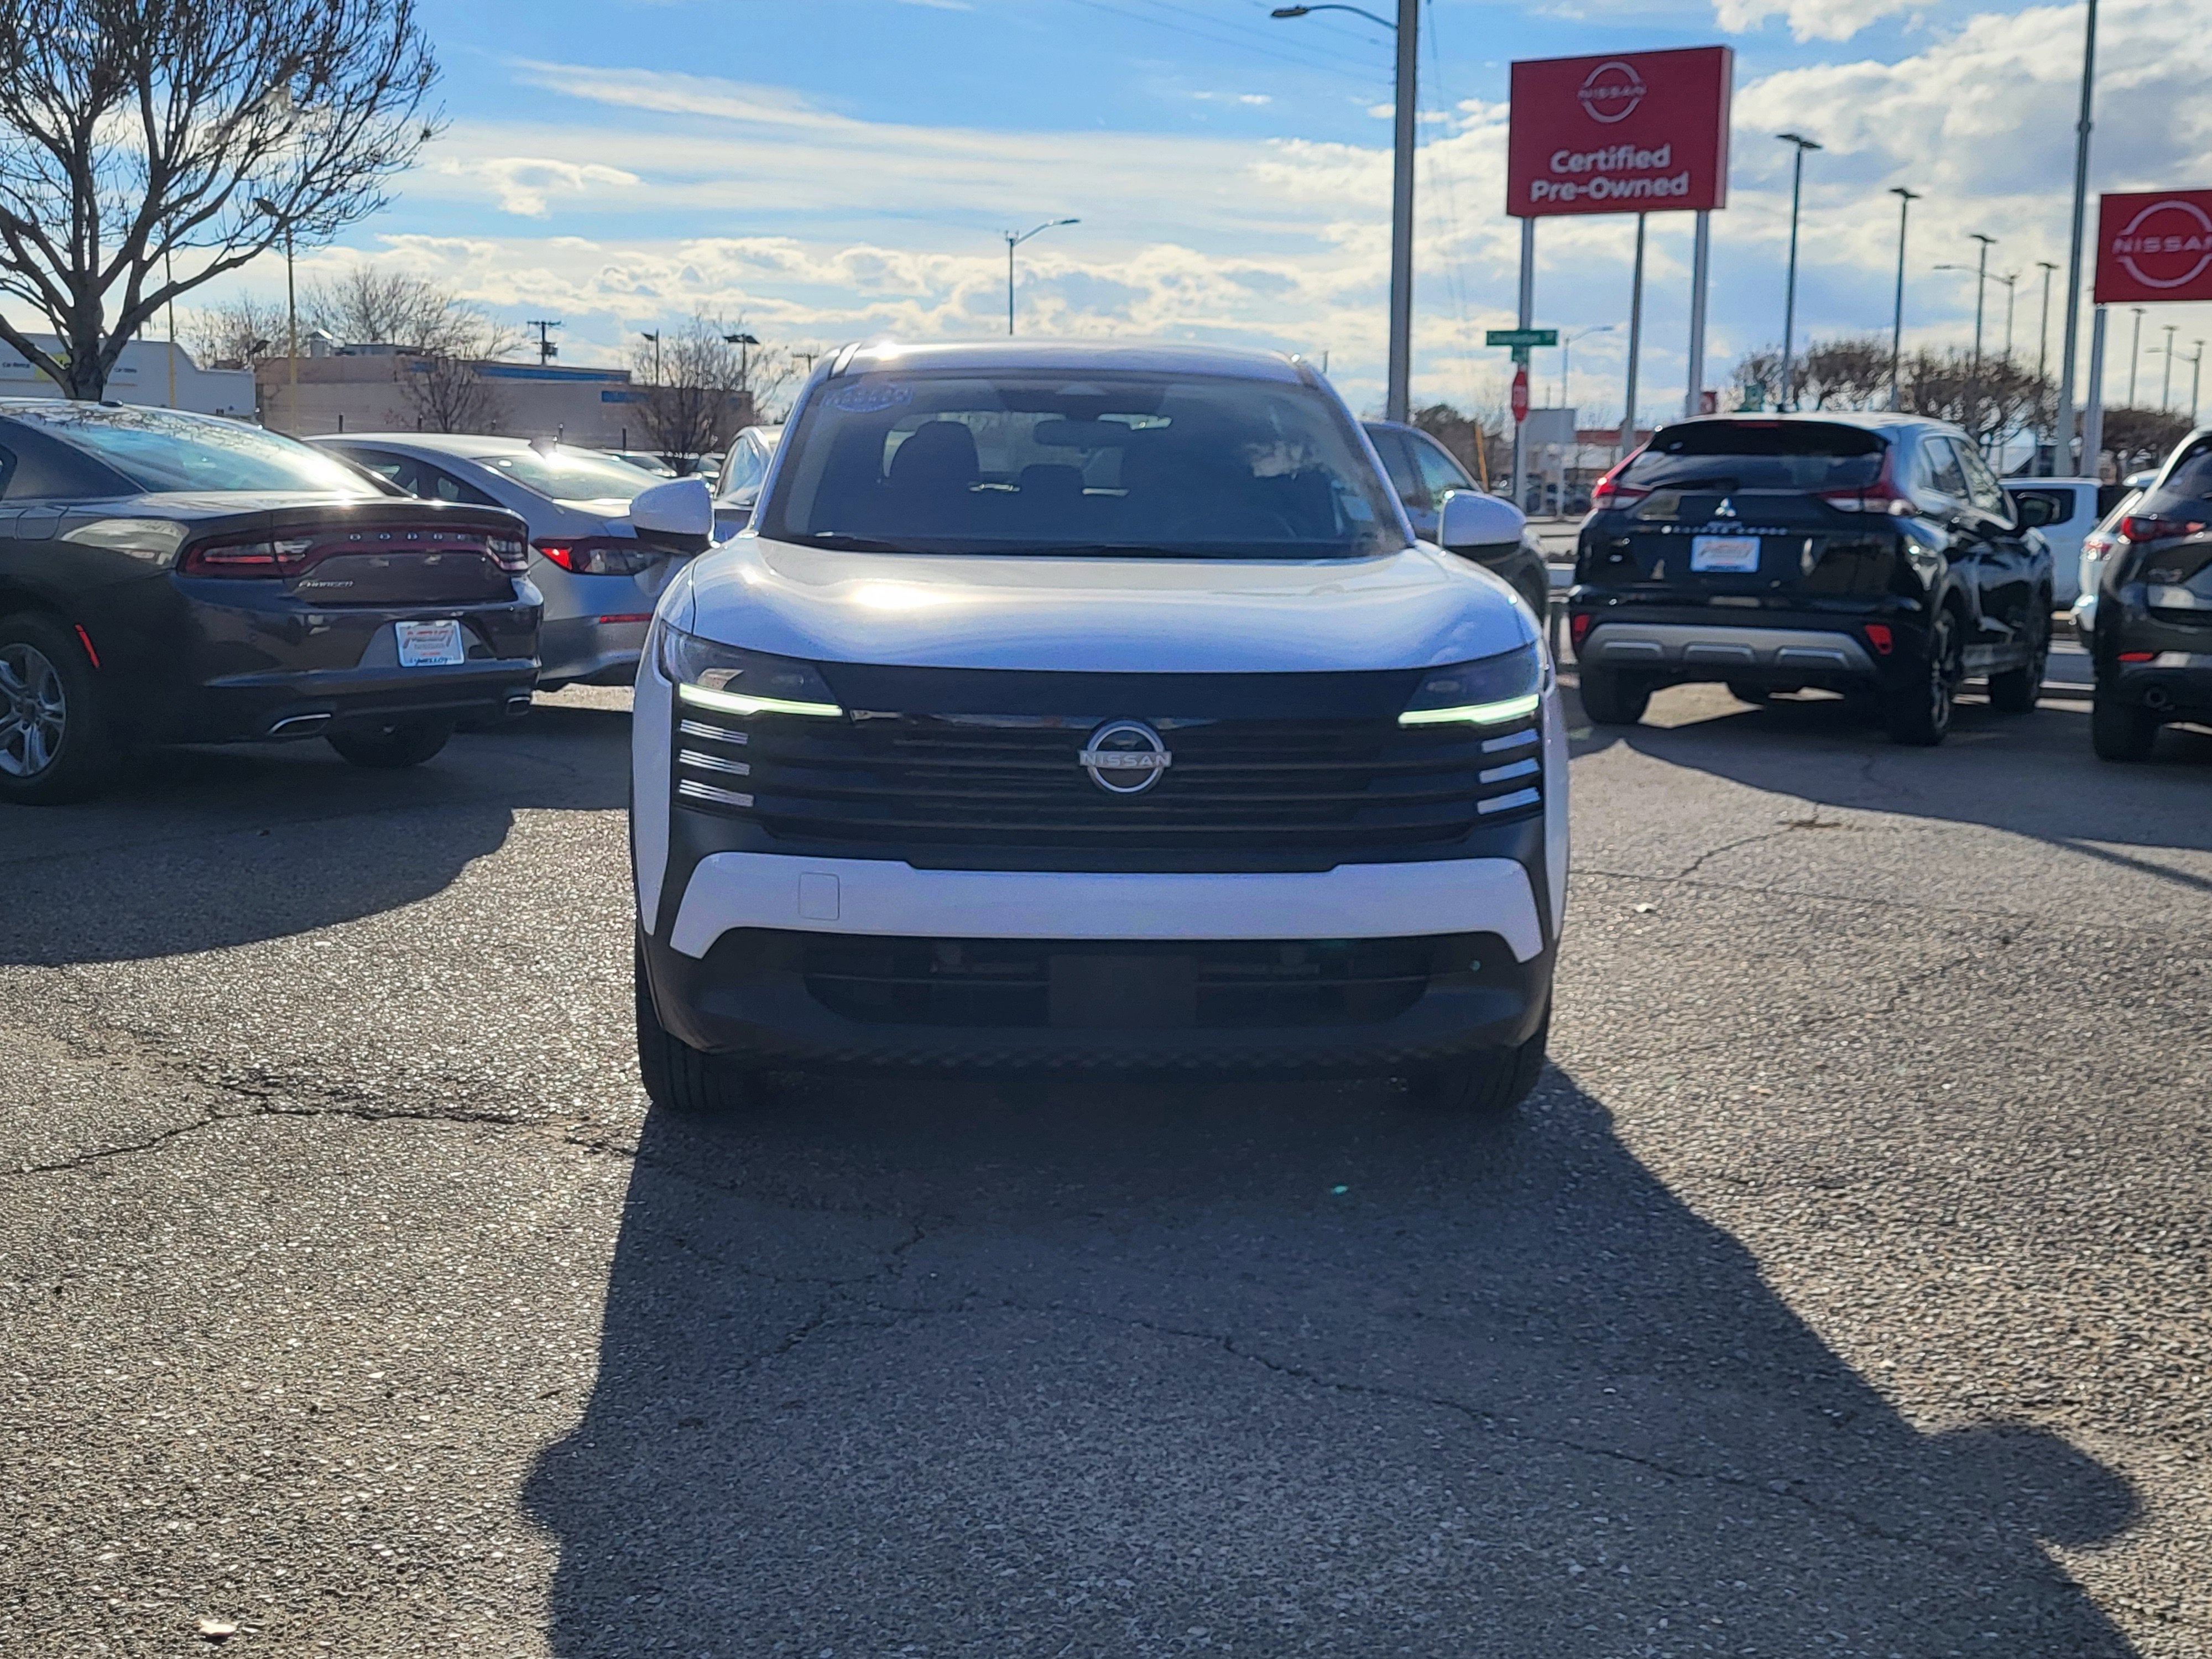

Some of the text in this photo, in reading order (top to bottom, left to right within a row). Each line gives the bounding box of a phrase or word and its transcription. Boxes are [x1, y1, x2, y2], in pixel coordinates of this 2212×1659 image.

[1550, 143, 1671, 174] Certified
[1530, 170, 1689, 202] Pre-Owned
[1082, 753, 1170, 767] NISSAN
